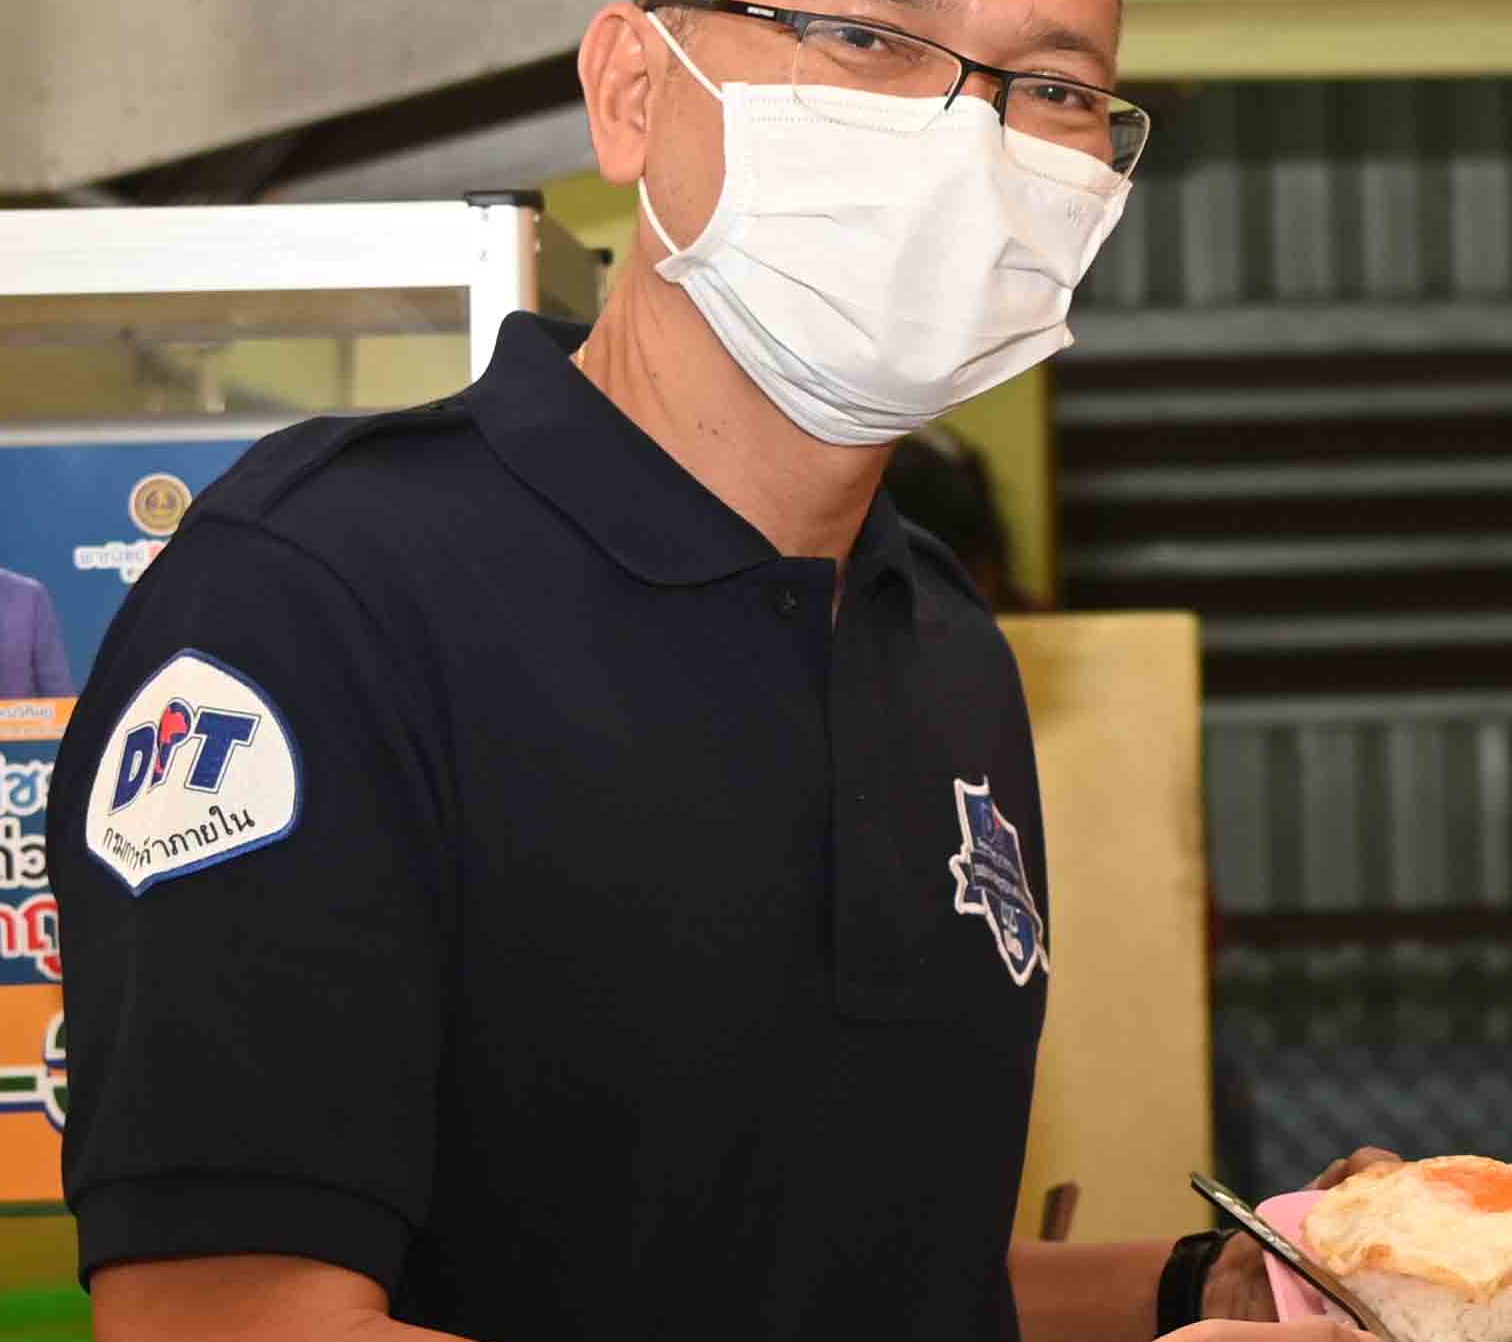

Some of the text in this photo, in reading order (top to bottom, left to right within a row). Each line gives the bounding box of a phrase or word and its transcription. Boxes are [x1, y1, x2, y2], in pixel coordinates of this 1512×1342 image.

[109, 698, 261, 816] DIT
[102, 806, 255, 870] กรมการค้าภายใน
